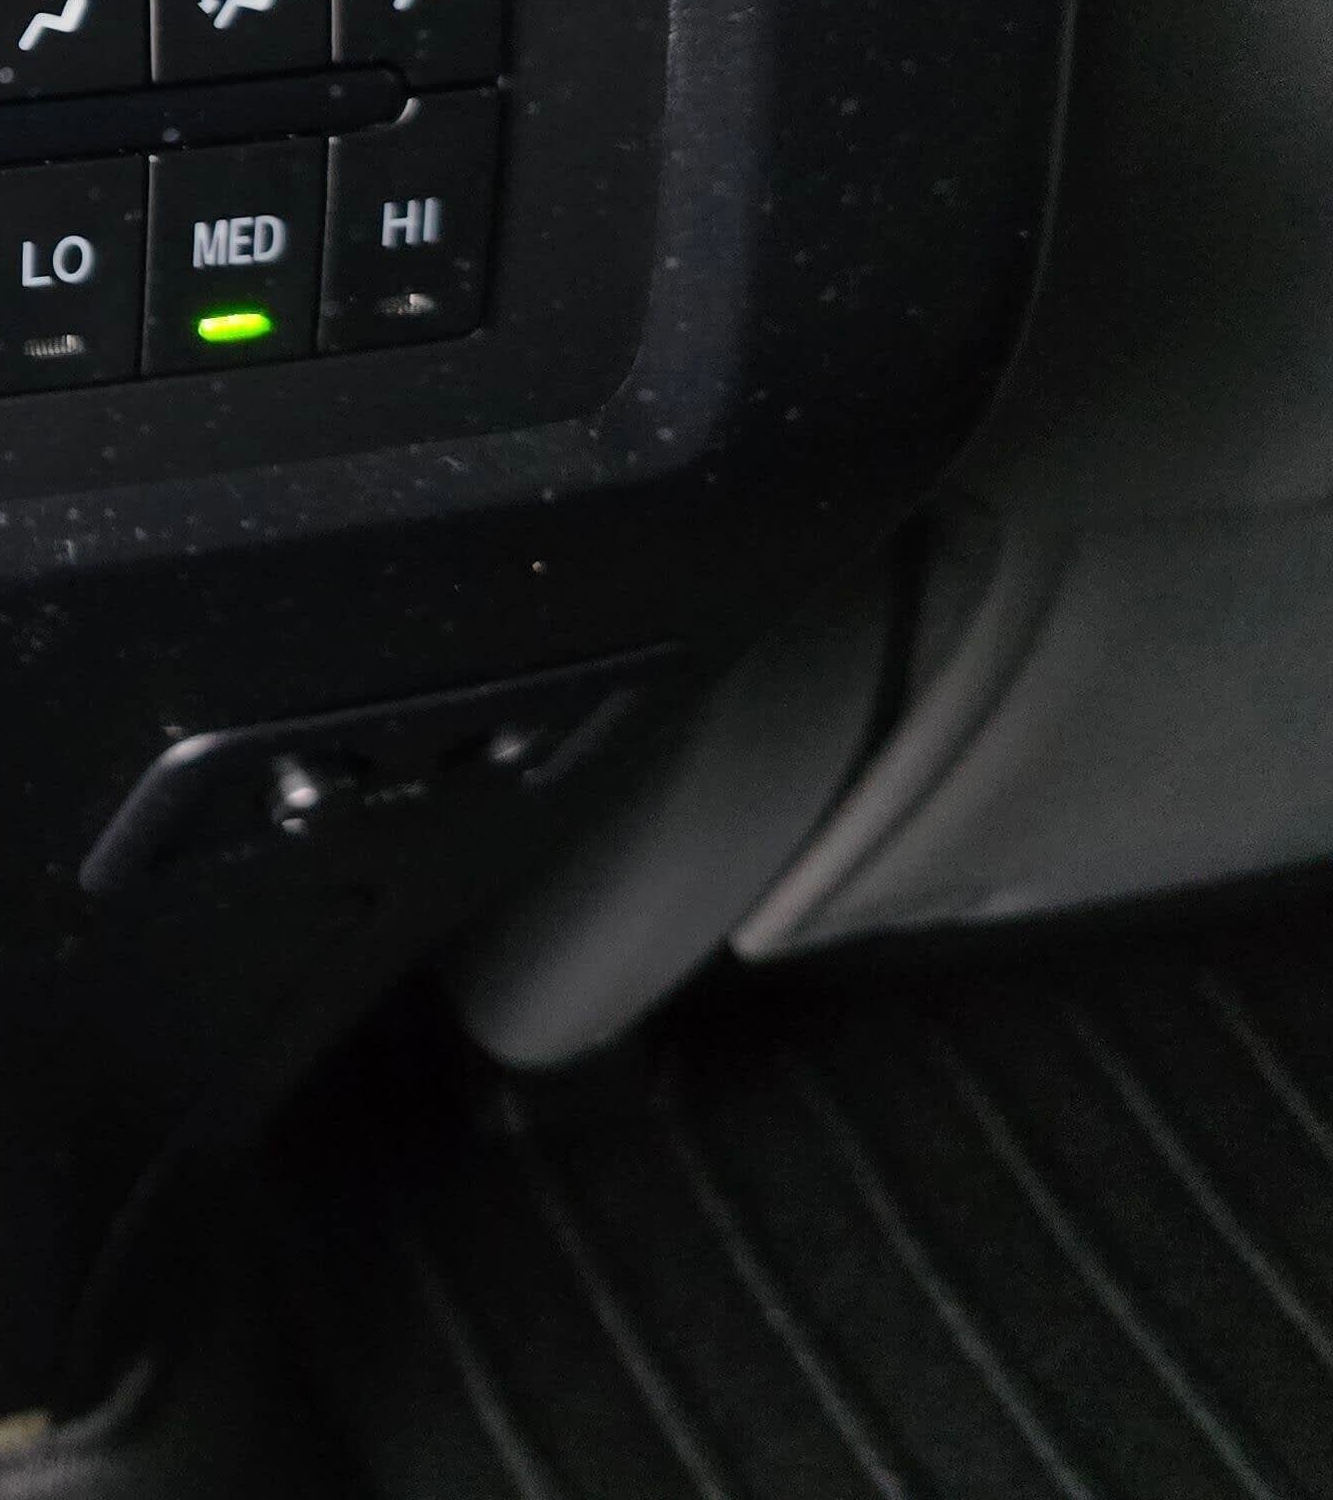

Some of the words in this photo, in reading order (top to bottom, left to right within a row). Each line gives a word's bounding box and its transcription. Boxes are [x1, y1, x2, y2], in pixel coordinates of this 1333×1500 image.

[192, 214, 286, 268] MED
[381, 197, 440, 248] HI
[21, 235, 95, 288] LO
